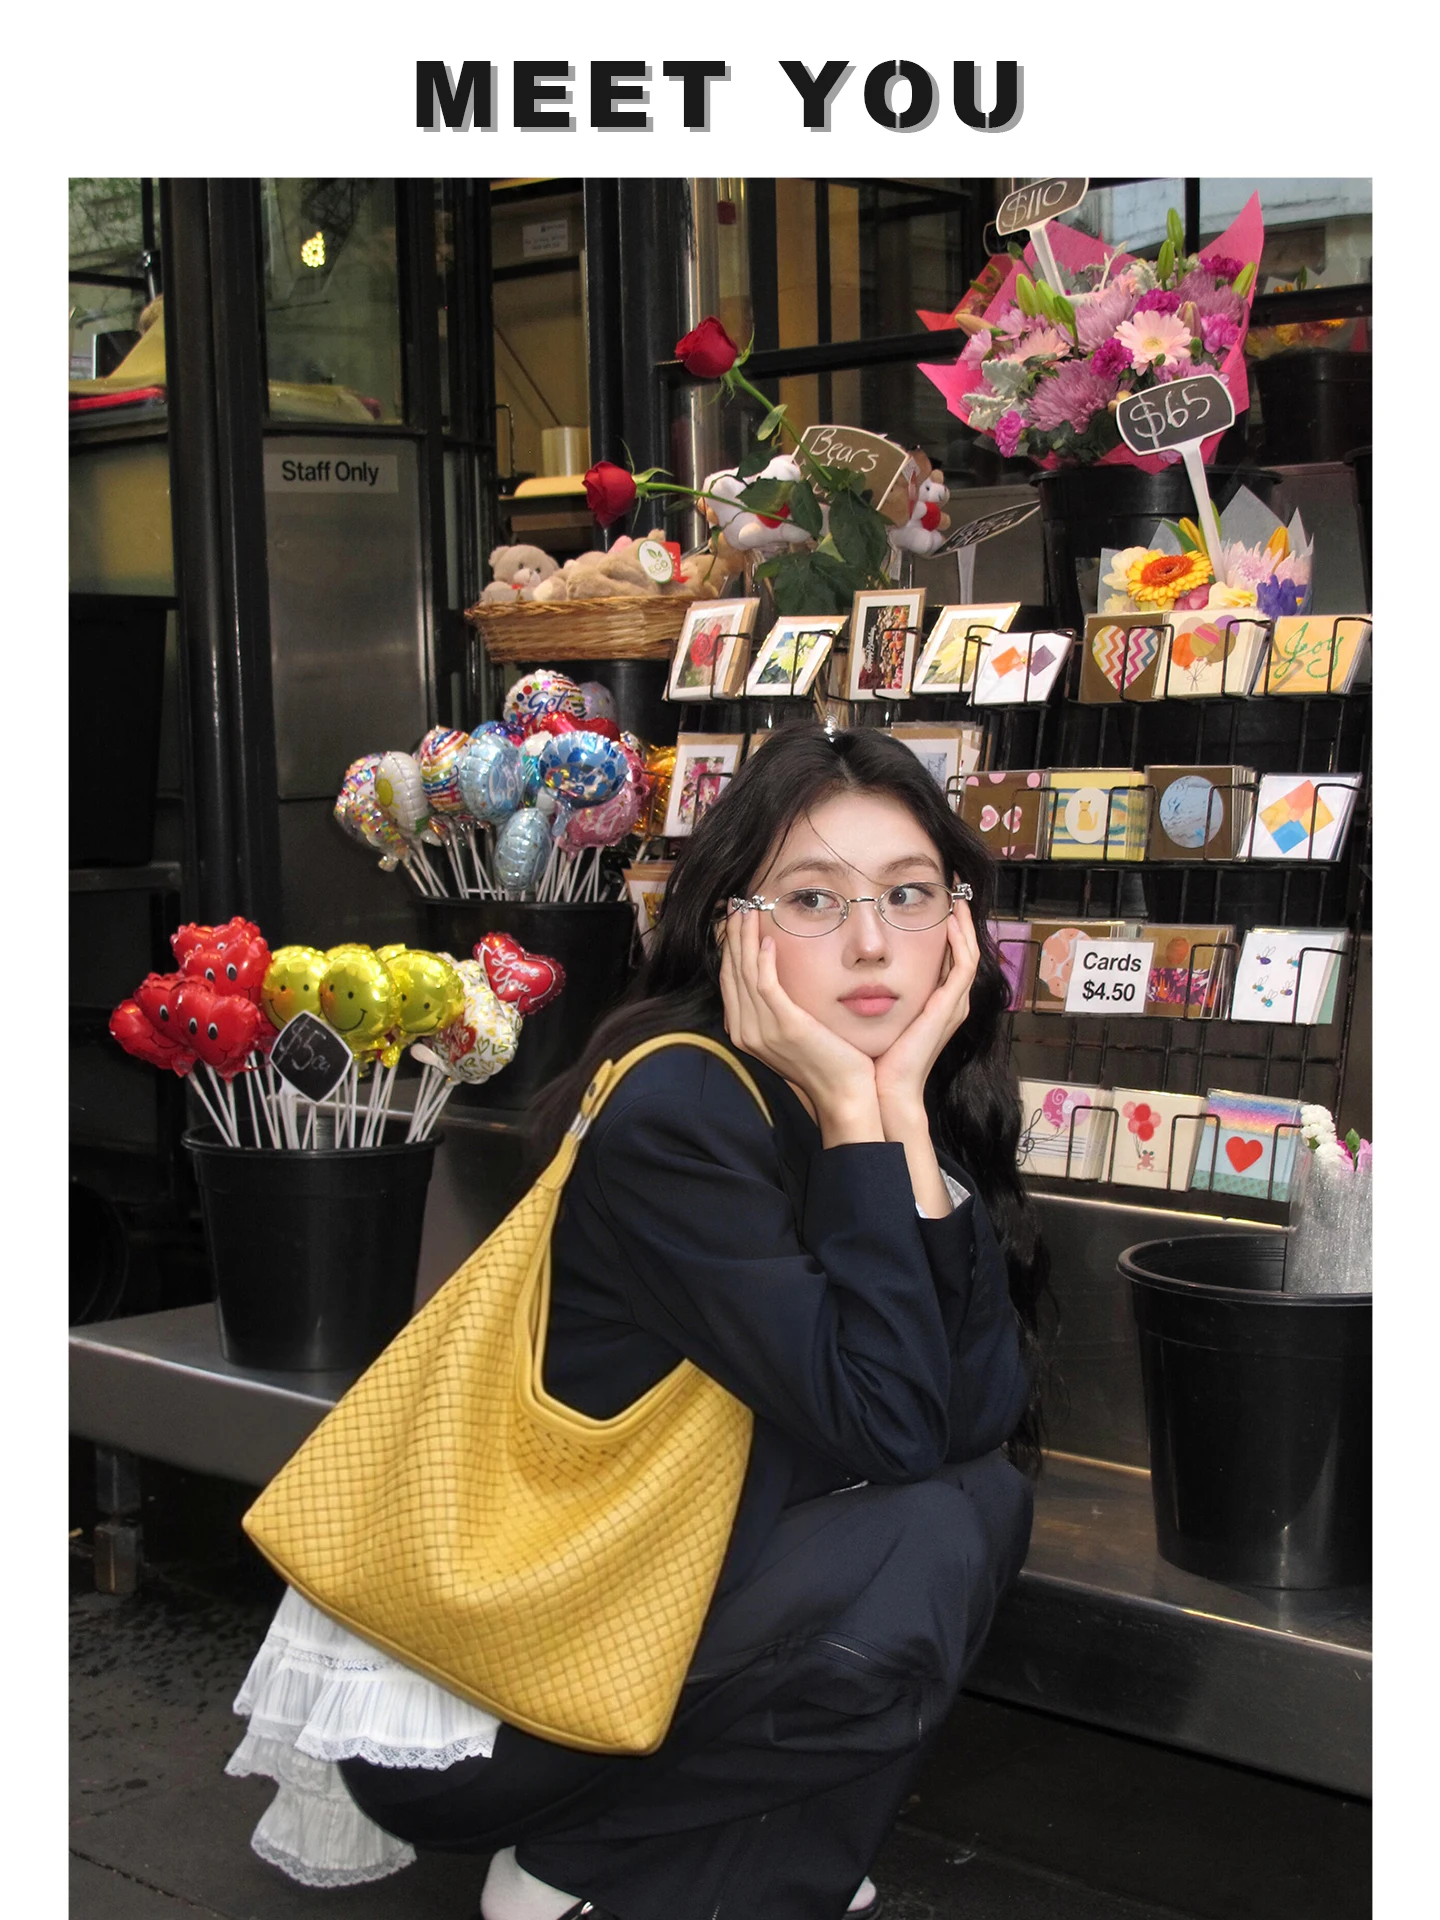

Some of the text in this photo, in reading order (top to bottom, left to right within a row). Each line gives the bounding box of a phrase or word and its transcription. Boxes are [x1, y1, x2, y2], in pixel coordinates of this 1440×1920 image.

[1001, 181, 1068, 231] $110
[1129, 383, 1211, 449] $65
[809, 428, 879, 473] Bears
[282, 460, 379, 486] Staff Only
[1273, 621, 1345, 679] Joy
[491, 945, 540, 978] Love
[1083, 951, 1142, 972] Cards
[493, 968, 531, 994] You
[1082, 979, 1136, 1002] $4.50
